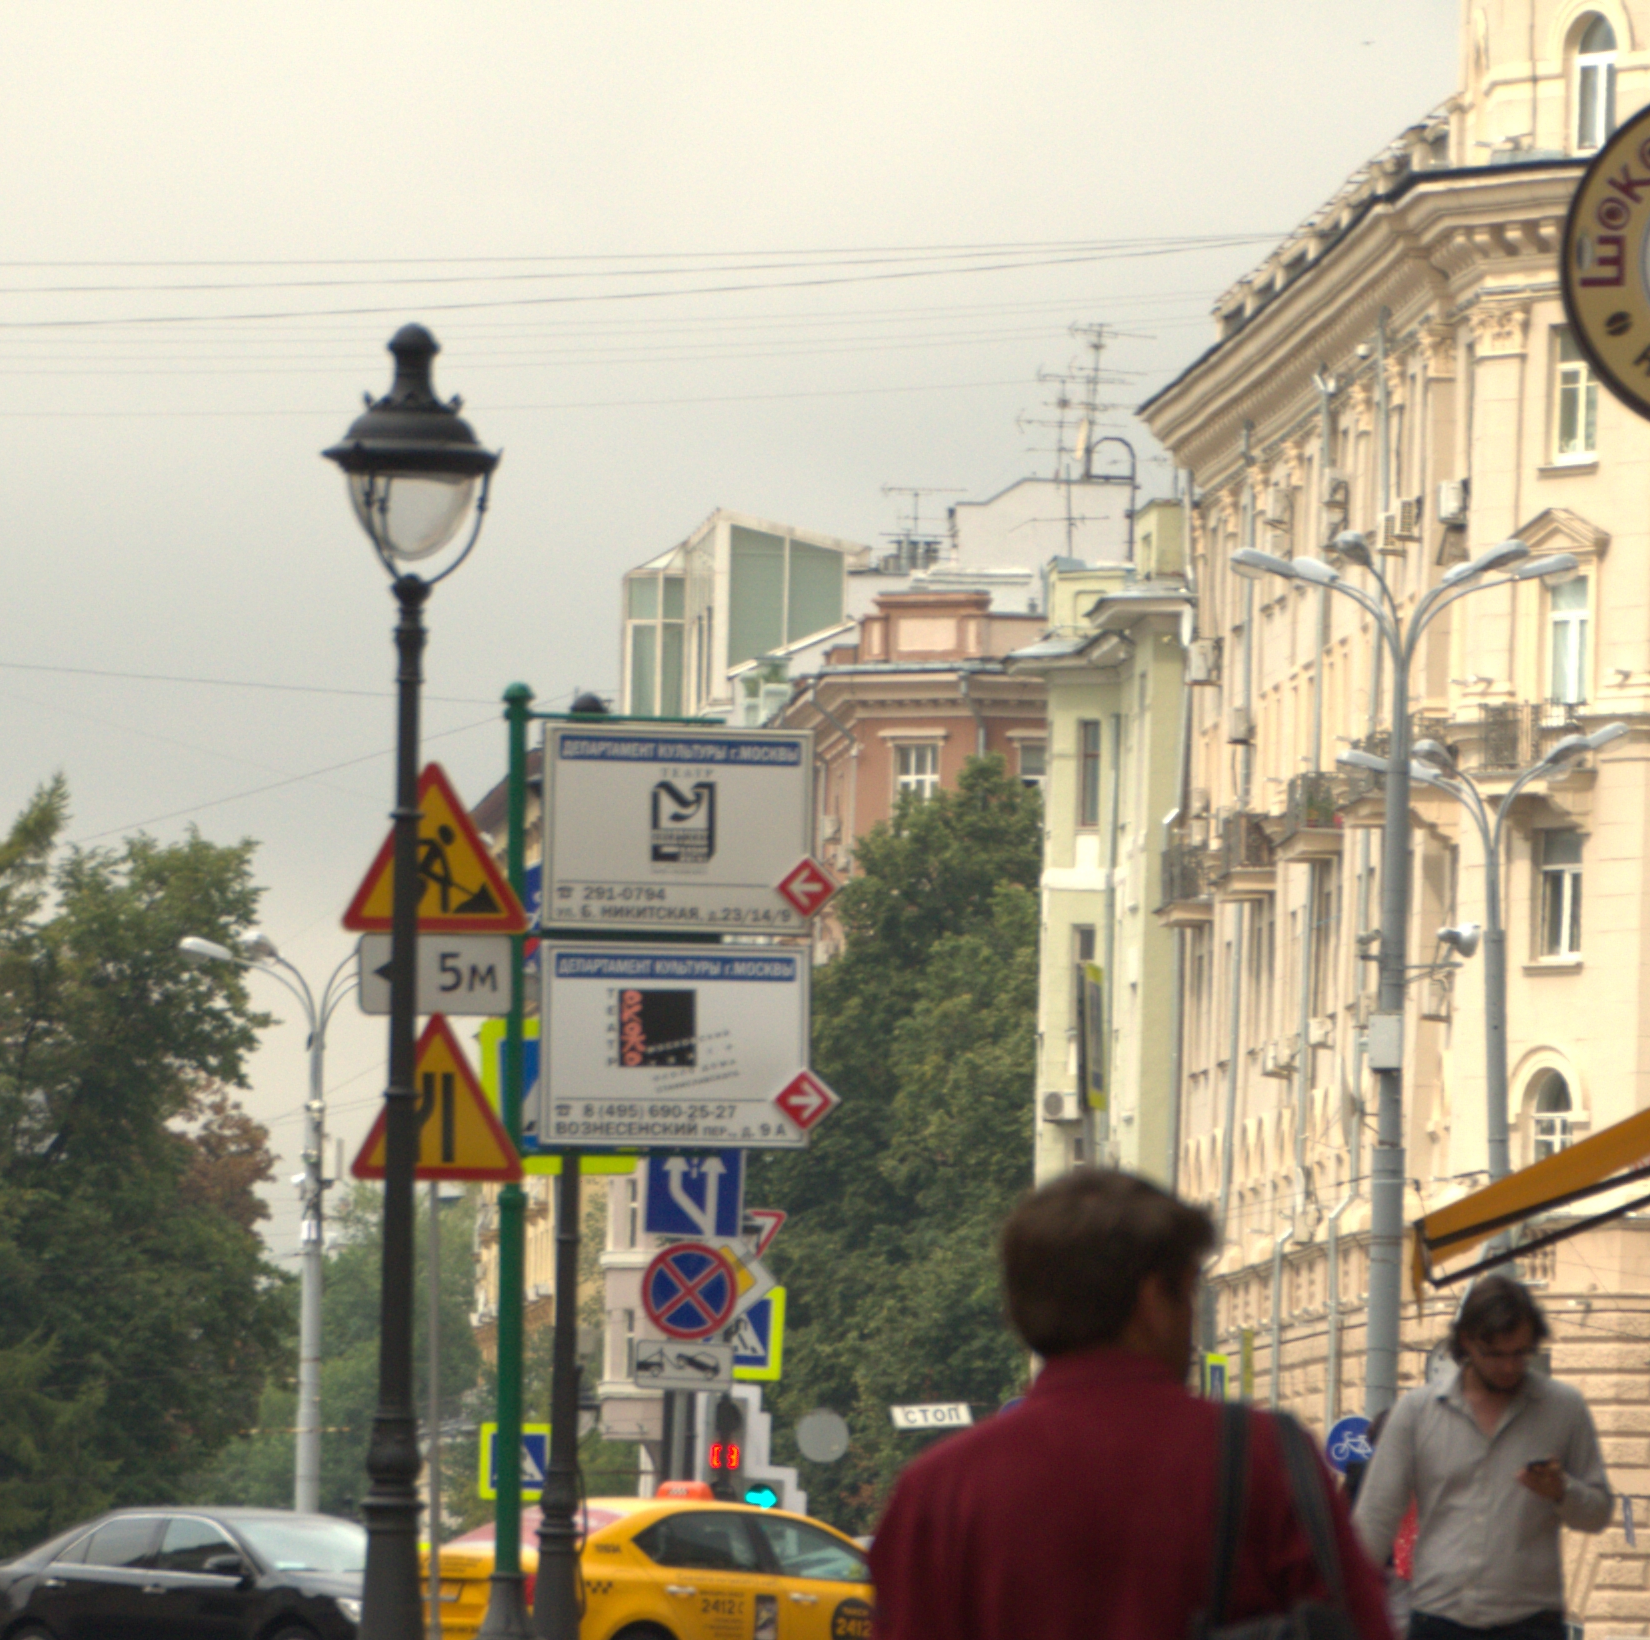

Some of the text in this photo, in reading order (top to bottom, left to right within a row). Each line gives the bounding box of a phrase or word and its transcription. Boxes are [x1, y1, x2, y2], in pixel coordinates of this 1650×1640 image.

[562, 739, 655, 758] ДЕПАРТАМЕНТ
[658, 742, 727, 761] КУЛЬТУРЫ
[583, 886, 666, 901] 291-0794
[559, 958, 652, 975] ДЕПАРТАМЕНТ
[655, 960, 721, 977] КУЛЬТУРЫ
[582, 1105, 594, 1118] 8
[648, 1104, 738, 1120] 690-25-27
[555, 1120, 699, 1136] ВОЗНЕСЕНСКИЙ
[904, 1407, 960, 1425] СТОП
